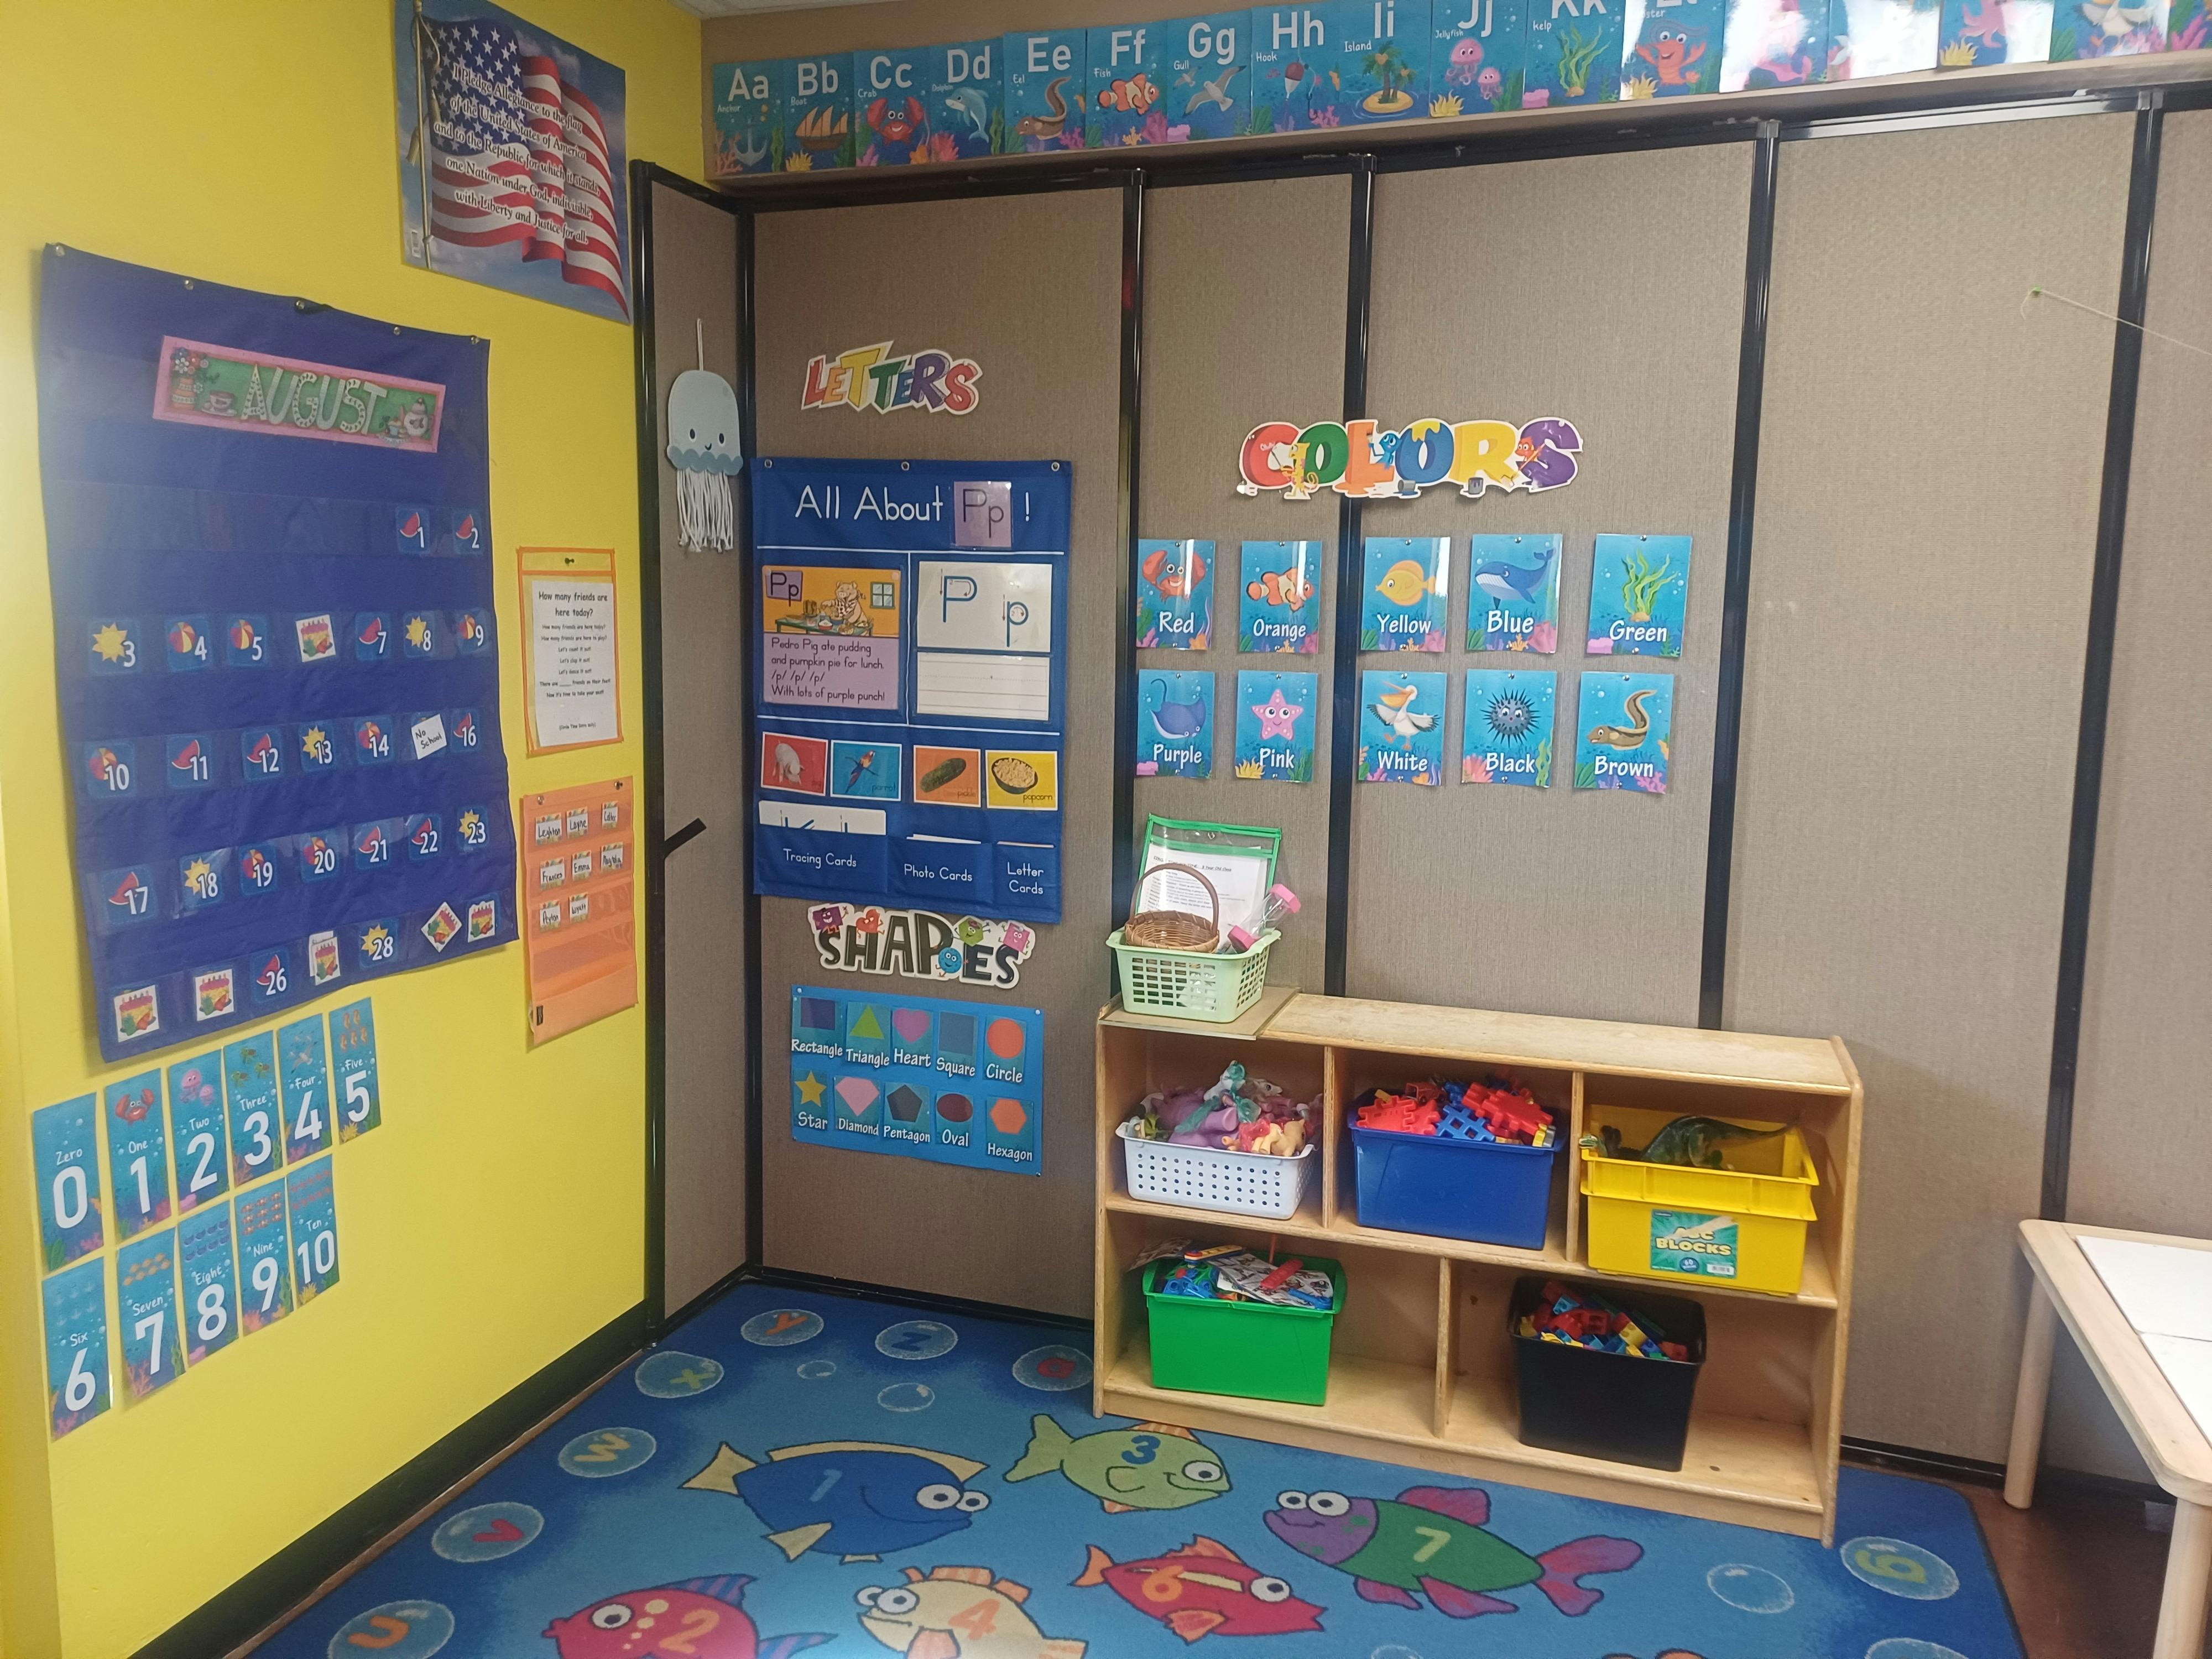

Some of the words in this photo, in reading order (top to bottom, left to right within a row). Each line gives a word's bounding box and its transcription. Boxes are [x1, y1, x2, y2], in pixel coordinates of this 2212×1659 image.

[1272, 11, 1324, 49] Hh
[1374, 1, 1394, 39] Ii
[1435, 29, 1464, 40] Jellyfish
[1532, 20, 1552, 33] kelp
[1028, 38, 1071, 72] Ee
[1111, 29, 1146, 66] Ff
[1188, 22, 1235, 65] Gg
[1256, 52, 1278, 62] Hook
[1344, 41, 1372, 53] Island
[798, 61, 838, 96] Bb
[870, 56, 912, 89] Cc
[947, 46, 990, 83] Dd
[1013, 74, 1025, 84] Eel
[1094, 68, 1111, 78] Fish
[1173, 60, 1190, 70] Gull
[453, 64, 458, 78] I
[461, 68, 492, 93] Pledge
[494, 84, 540, 113] Allegiance
[542, 106, 550, 118] to
[553, 109, 566, 124] the
[566, 115, 582, 134] flag
[728, 68, 769, 101] Aa
[858, 88, 877, 98] Crab
[451, 96, 460, 112] of
[463, 100, 477, 116] the
[479, 105, 512, 131] United
[515, 120, 540, 141] States
[542, 133, 551, 148] of
[553, 139, 586, 160] America
[435, 123, 452, 137] and
[456, 129, 465, 142] to
[467, 132, 482, 148] the
[485, 139, 524, 163] Republic
[526, 154, 538, 169] for
[540, 160, 565, 180] which
[566, 170, 573, 183] it
[575, 176, 600, 195] stands,
[447, 159, 463, 171] one
[466, 161, 499, 184] Nation
[502, 177, 527, 193] under
[530, 184, 550, 204] God,
[552, 193, 593, 219] indivisible,
[456, 191, 477, 206] with
[480, 196, 513, 220] Liberty
[515, 211, 531, 224] and
[533, 214, 560, 234] Justice
[562, 224, 574, 239] for
[576, 229, 588, 243] all.
[804, 346, 979, 412] LETTERS
[241, 363, 387, 435] AUGUST
[1243, 419, 1582, 491] COLORS
[795, 485, 839, 519] All
[854, 484, 943, 521] About
[962, 488, 1004, 539] Pp
[1025, 492, 1030, 522] !
[539, 590, 552, 601] How
[555, 593, 571, 603] many
[574, 591, 595, 602] friends
[770, 572, 800, 607] Pp
[555, 607, 570, 616] here
[572, 608, 593, 619] today?
[943, 575, 978, 623] P
[1006, 601, 1029, 648] p
[1159, 611, 1194, 633] Red
[1253, 618, 1307, 641] Orange
[1376, 614, 1432, 634] Yellow
[1487, 610, 1534, 633] Blue
[1609, 619, 1667, 643] Green
[378, 632, 387, 654] 7
[423, 629, 431, 651] 8
[475, 625, 484, 647] 9
[771, 637, 799, 649] Pedro
[802, 638, 818, 655] Pig
[821, 640, 836, 651] ate
[838, 641, 872, 657] pudding
[771, 653, 787, 665] and
[789, 654, 825, 670] pumpkin
[828, 659, 841, 671] pie
[844, 656, 858, 667] for
[860, 658, 885, 670] lunch.
[771, 670, 787, 684] /p/
[790, 670, 806, 685] /p/
[809, 671, 826, 686] /p/
[771, 684, 794, 696] With
[797, 686, 812, 697] lots
[815, 687, 826, 698] of
[827, 688, 855, 703] purple
[858, 690, 885, 705] punch!
[415, 729, 426, 739] No
[420, 733, 442, 749] School
[1153, 744, 1202, 769] Purple
[1259, 747, 1295, 769] Pink
[1378, 750, 1428, 771] White
[1485, 752, 1536, 774] Black
[1594, 755, 1654, 778] Brown
[1022, 794, 1053, 804] popcorn
[468, 822, 486, 844] 23
[542, 870, 563, 883] Frances
[574, 863, 590, 874] Emma
[783, 848, 821, 869] Tracing
[825, 852, 857, 868] Cards
[904, 863, 935, 878] Photo
[939, 867, 973, 881] Cards
[1007, 861, 1044, 877] Letter
[197, 872, 218, 899] 18
[253, 861, 273, 887] 19
[1009, 879, 1044, 895] Cards
[818, 912, 1020, 984] SHAPES
[267, 967, 286, 995] 26
[345, 1058, 363, 1071] Five
[791, 1039, 843, 1058] Rectangle
[846, 1048, 890, 1068] Triangle
[894, 1048, 931, 1067] Heart
[936, 1057, 975, 1077] Square
[986, 1063, 1022, 1083] Circle
[295, 1074, 316, 1090] Four
[345, 1070, 370, 1123] 5
[239, 1094, 267, 1112] Three
[294, 1089, 322, 1140] 4
[189, 1117, 210, 1131] Two
[243, 1110, 272, 1166] 3
[798, 1111, 828, 1129] Star
[838, 1118, 879, 1136] Diamond
[883, 1125, 930, 1144] Pentagon
[942, 1129, 969, 1147] Oval
[987, 1142, 1032, 1162] Hexagon
[56, 1147, 83, 1166] Zero
[128, 1140, 148, 1154] One
[187, 1133, 218, 1193] 2
[53, 1166, 88, 1229] 0
[130, 1155, 151, 1214] 1
[306, 1218, 322, 1231] Ten
[253, 1240, 274, 1258] Nine
[296, 1230, 335, 1284] 10
[1655, 1237, 1732, 1256] BLOCKS
[195, 1264, 223, 1287] Eight
[252, 1257, 278, 1312] 9
[133, 1295, 164, 1317] Seven
[197, 1284, 227, 1341] 8
[70, 1331, 88, 1346] Six
[134, 1310, 164, 1375] 7
[65, 1347, 96, 1412] 6
[1121, 1434, 1162, 1465] 3
[1141, 1565, 1185, 1602] 6
